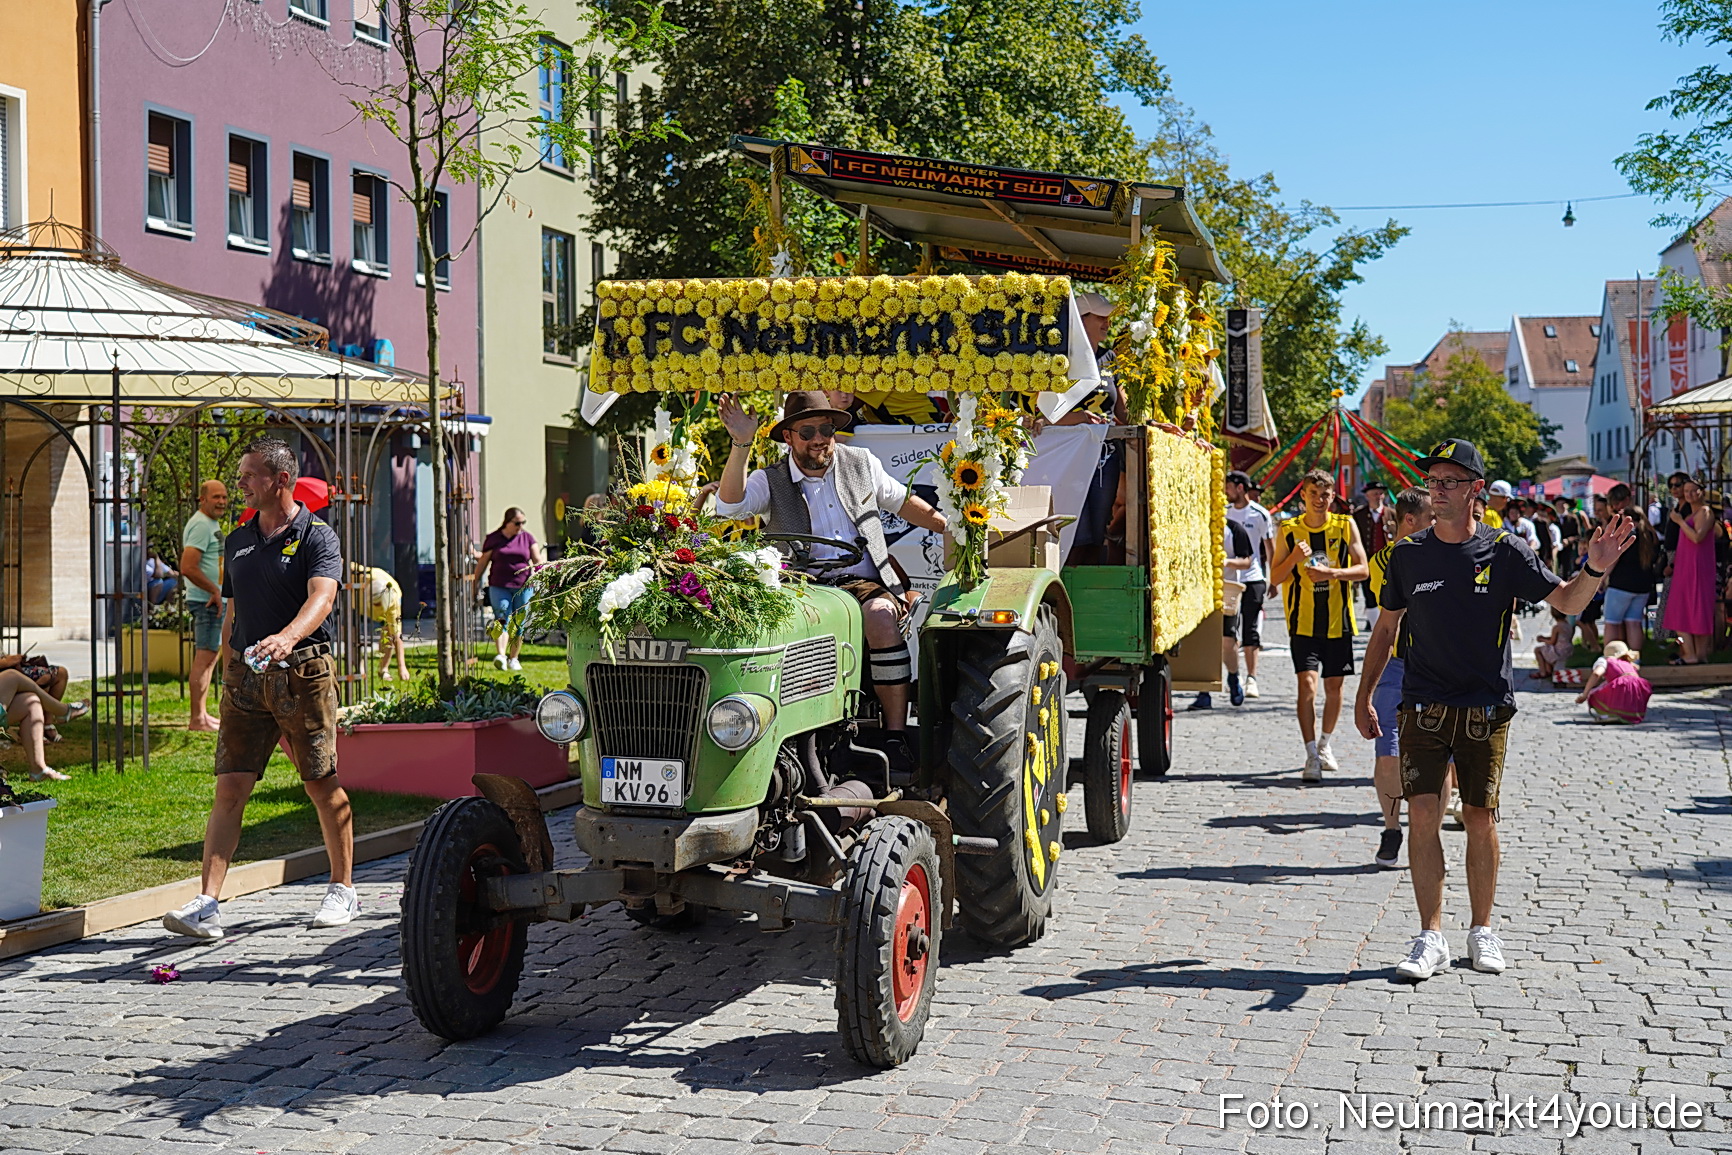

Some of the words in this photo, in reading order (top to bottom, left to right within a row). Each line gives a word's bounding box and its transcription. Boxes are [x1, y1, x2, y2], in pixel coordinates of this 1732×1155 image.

[833, 159, 844, 170] 1.
[848, 161, 876, 175] FC
[880, 165, 1009, 191] NEUMARKT
[1013, 181, 1062, 196] SÜD
[893, 158, 945, 171] YOU'LL
[948, 165, 999, 178] NEVER
[893, 179, 936, 190] WALK
[942, 186, 995, 198] ALONE
[1012, 255, 1115, 275] NEUMARKT
[1024, 265, 1058, 274] WALK
[643, 312, 708, 357] FC
[1669, 340, 1687, 391] SALE
[616, 760, 642, 781] NM
[614, 782, 641, 802] KV
[644, 783, 669, 804] 96
